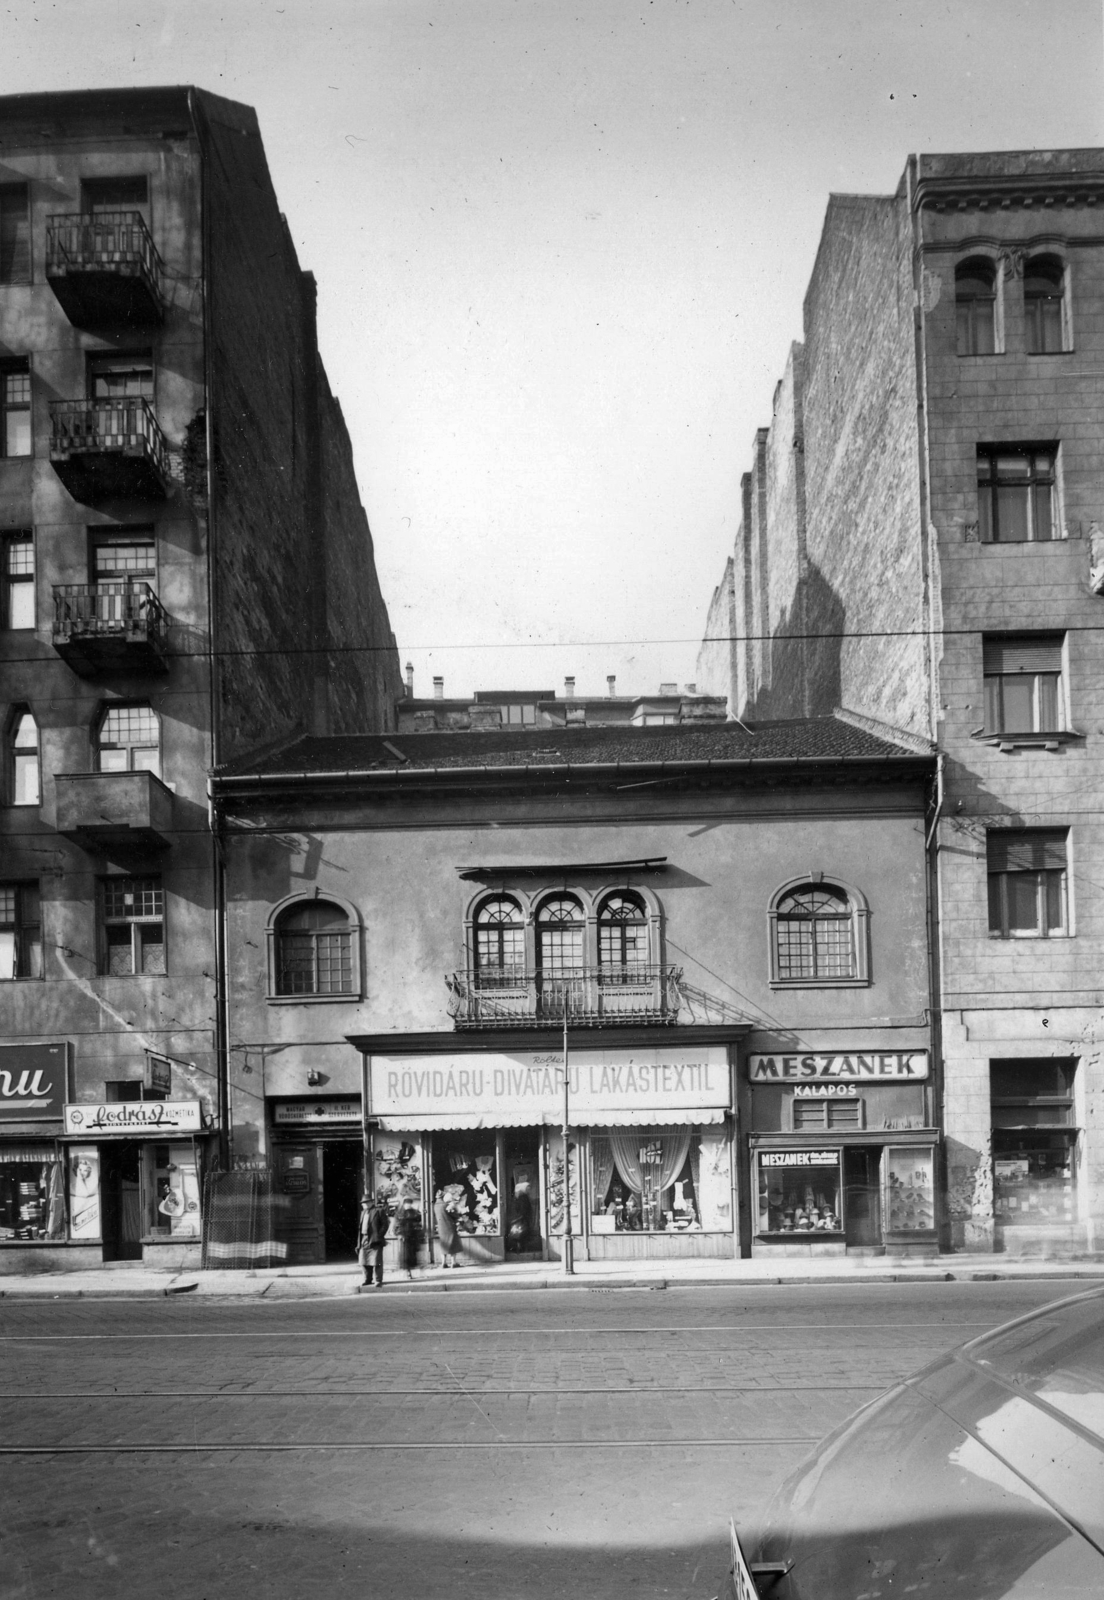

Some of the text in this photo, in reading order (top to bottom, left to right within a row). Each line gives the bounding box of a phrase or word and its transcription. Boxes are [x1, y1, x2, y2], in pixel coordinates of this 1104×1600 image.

[754, 1054, 915, 1078] MESZANEK
[590, 1059, 715, 1094] LAKÁSTEXTIL
[794, 1084, 857, 1097] KALAPOS
[761, 1153, 811, 1166] MESZANEK
